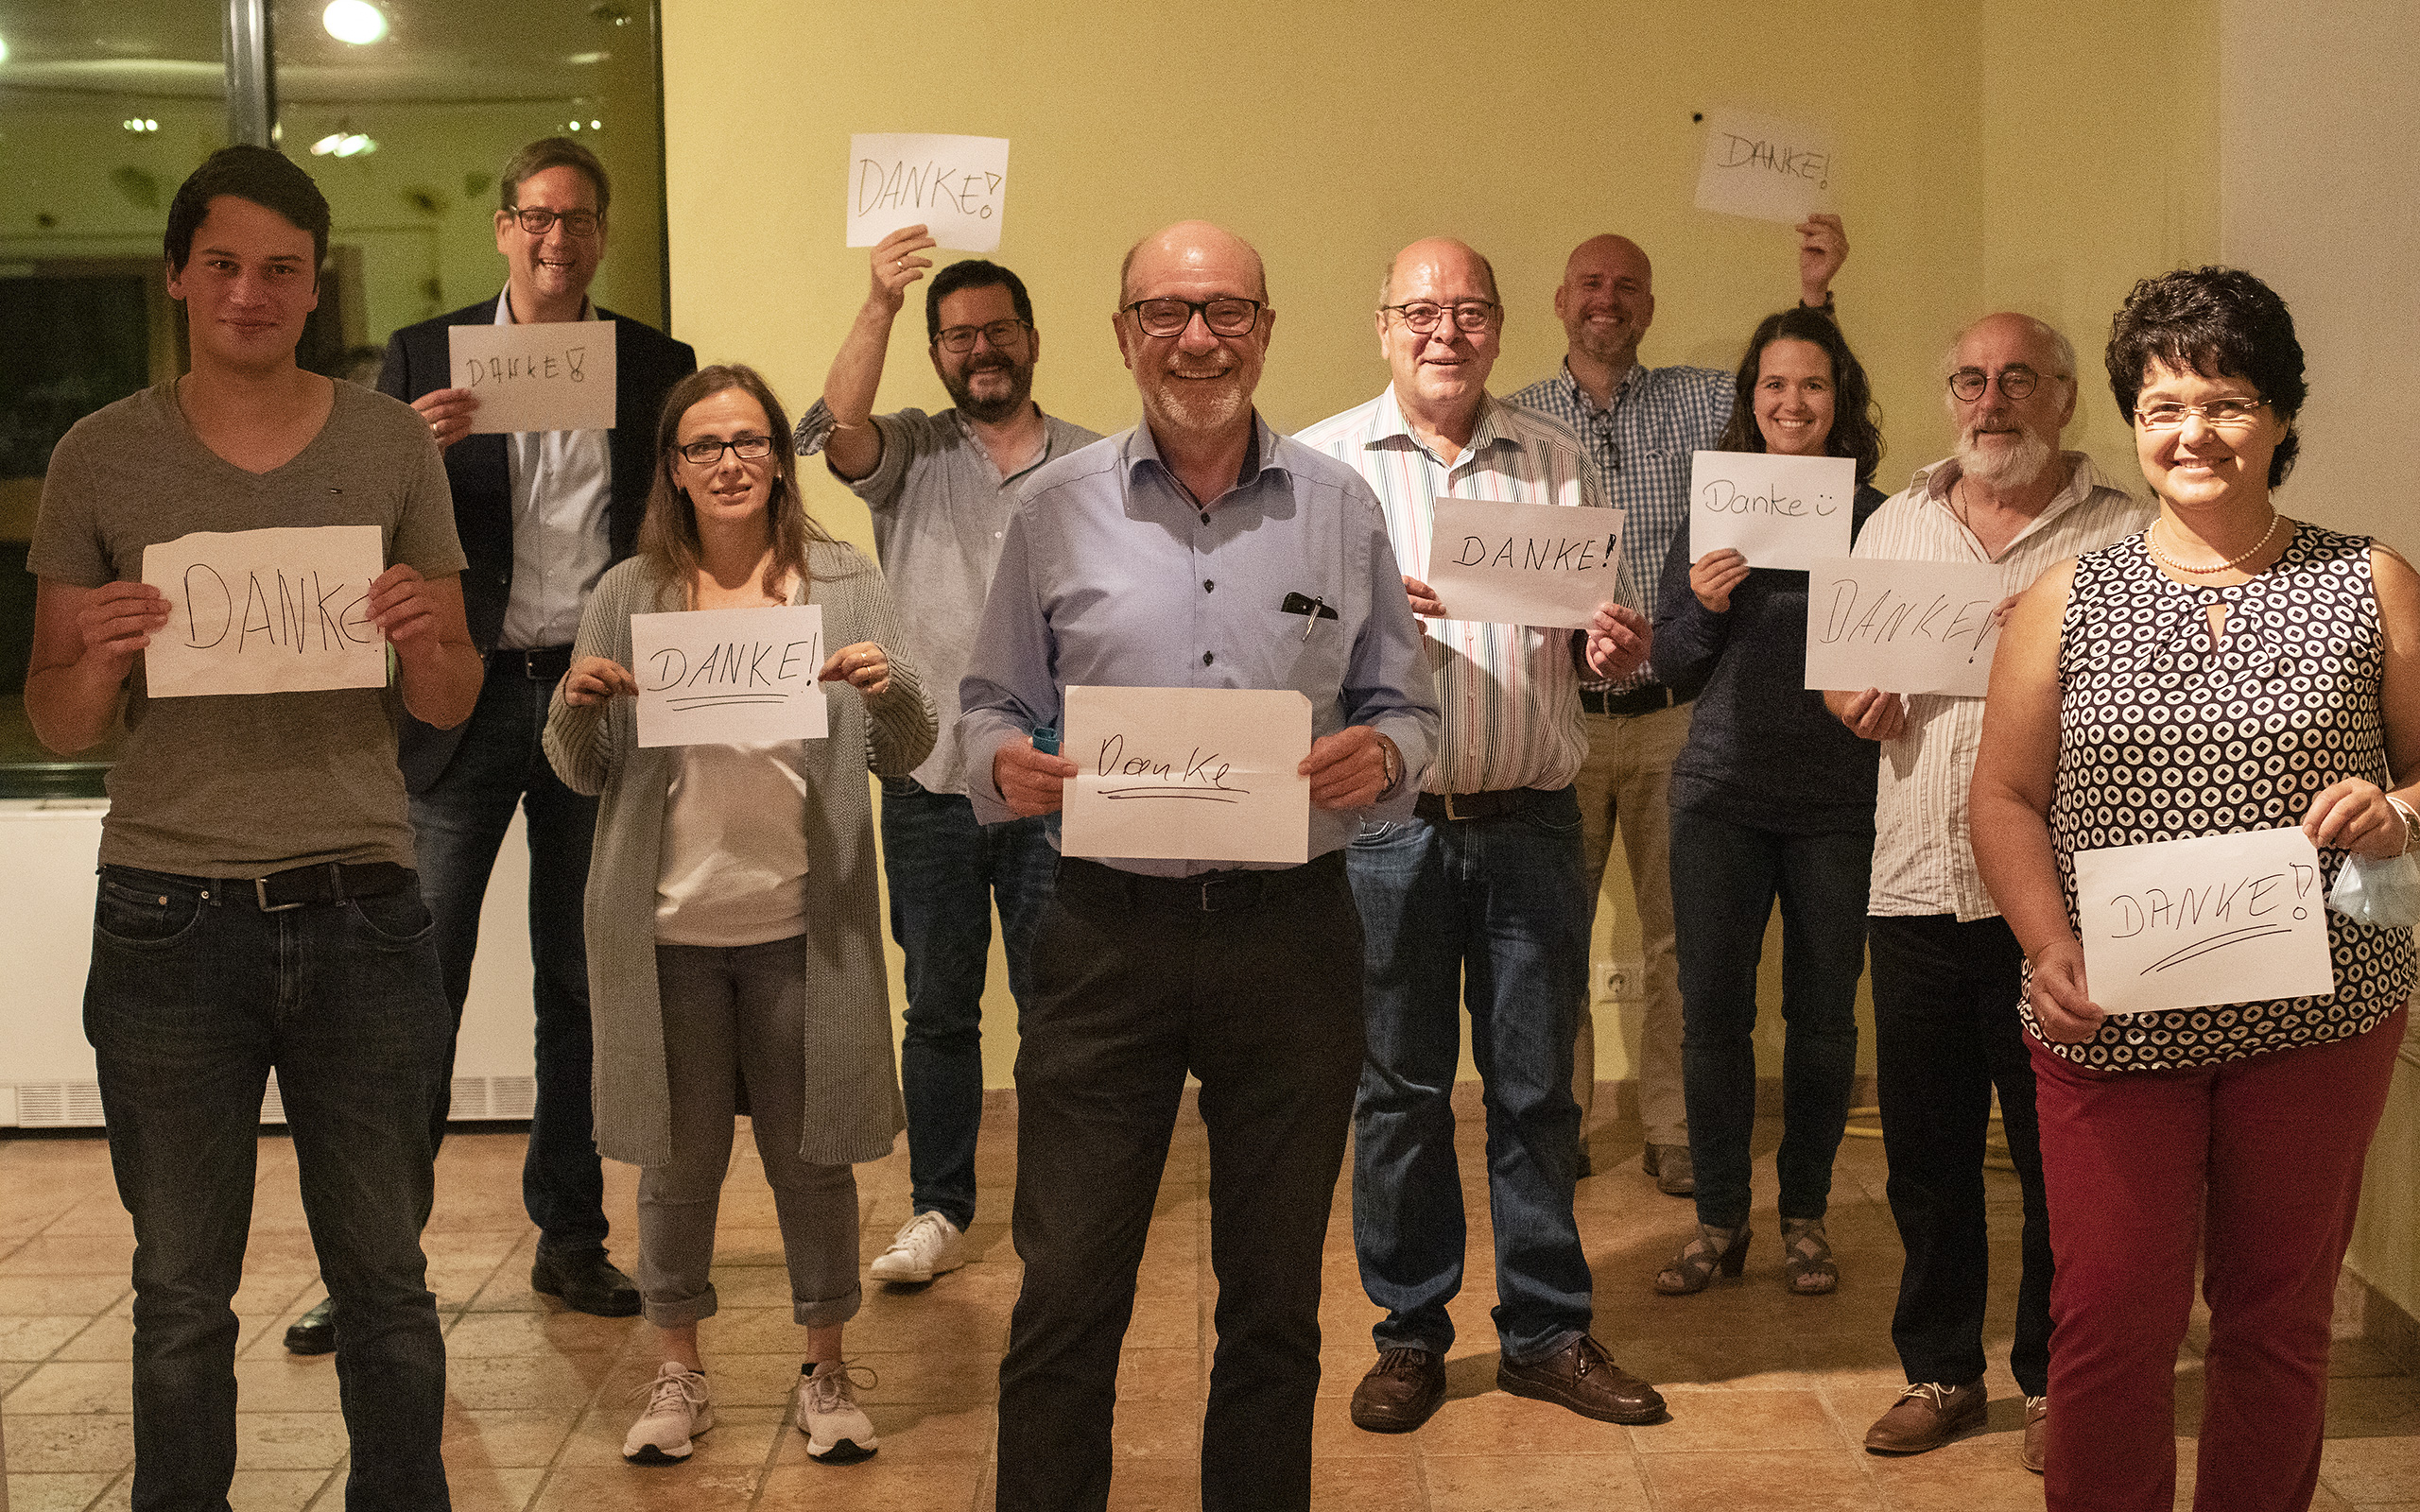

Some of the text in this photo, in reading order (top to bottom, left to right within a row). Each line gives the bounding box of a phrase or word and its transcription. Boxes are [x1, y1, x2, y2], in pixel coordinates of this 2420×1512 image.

[858, 159, 1002, 219] DANKE!
[1717, 132, 1830, 189] DANKE!
[466, 347, 585, 388] DANKE!
[1703, 479, 1808, 516] Danke
[1452, 533, 1617, 571] DANKE!
[647, 632, 818, 692] DANKE!
[2110, 862, 2314, 938] DANKE!
